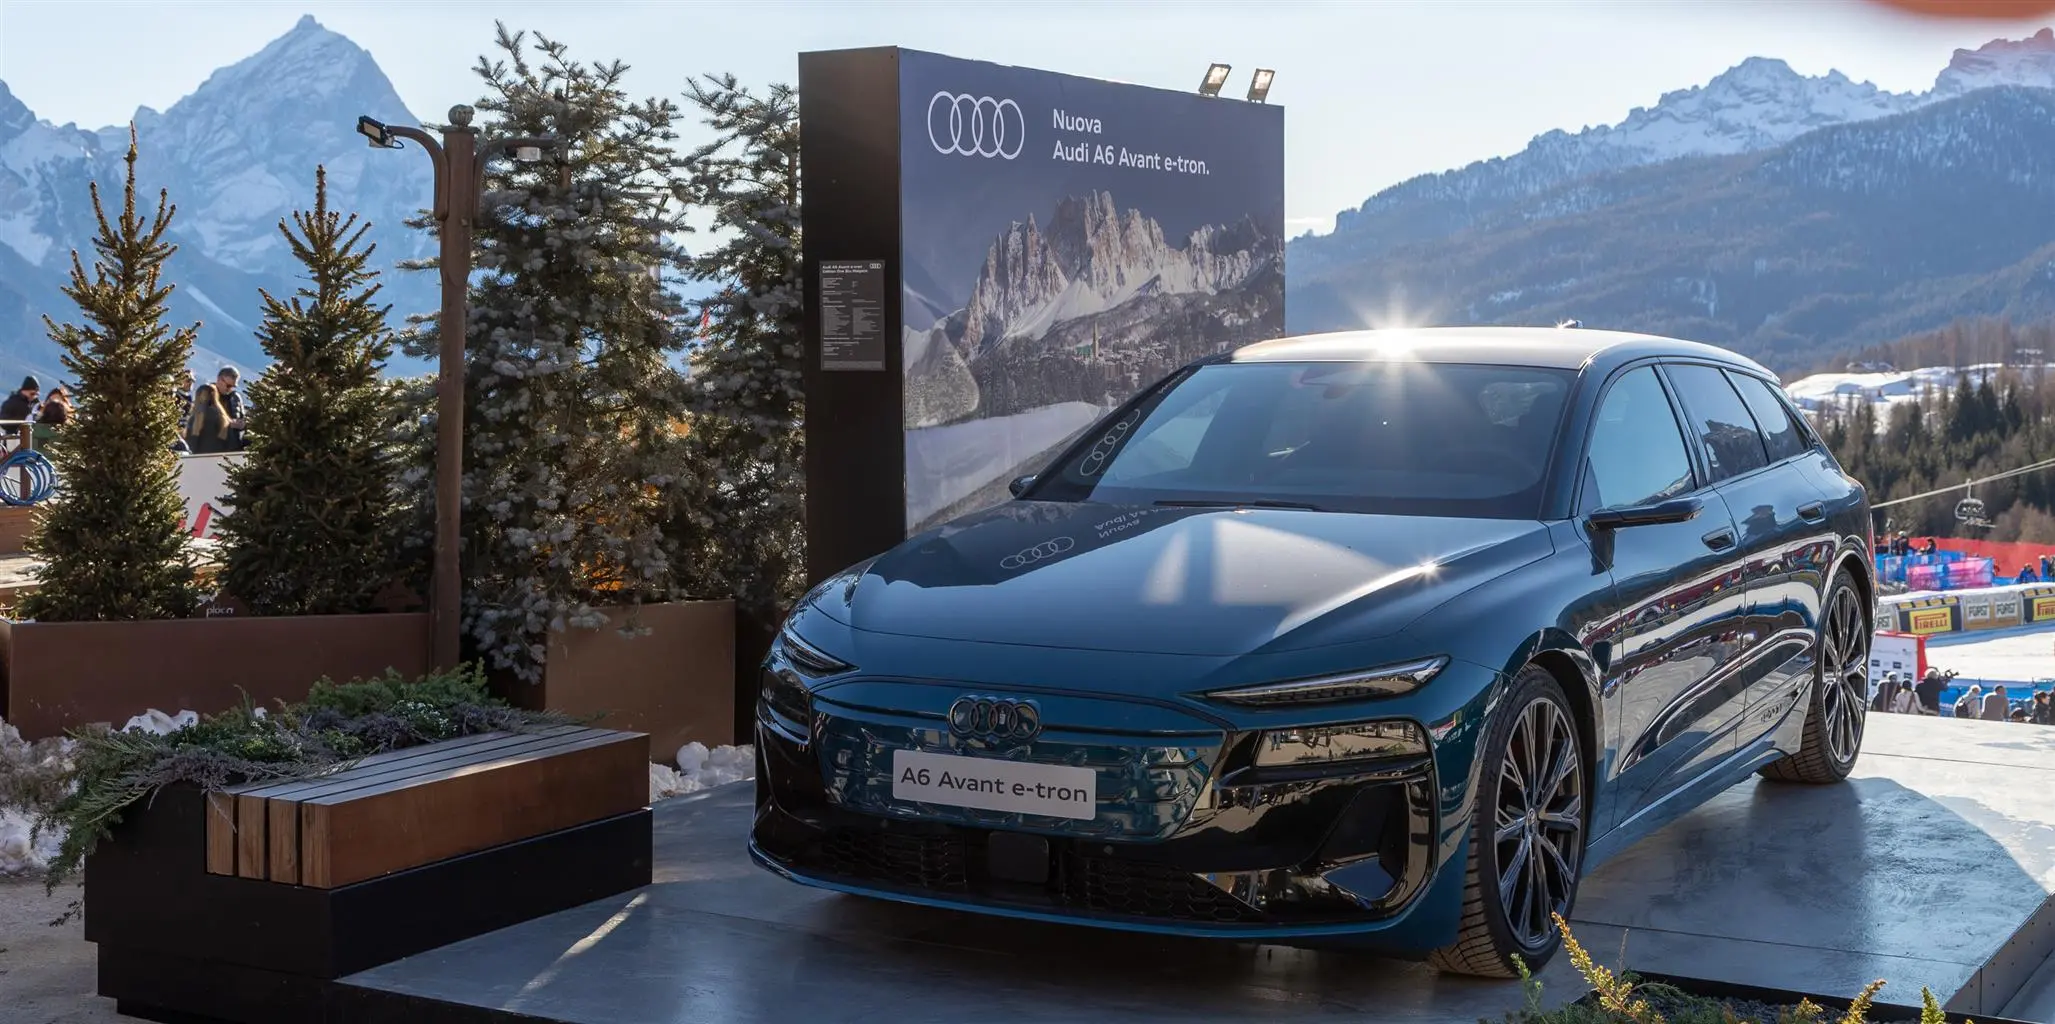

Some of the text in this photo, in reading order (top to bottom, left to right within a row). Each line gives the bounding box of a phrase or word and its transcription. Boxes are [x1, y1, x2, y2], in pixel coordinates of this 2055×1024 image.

[1053, 108, 1102, 134] Nuova
[1053, 139, 1210, 175] Audi A6 Avant e-tron.
[1914, 612, 1948, 630] PIRELLI
[901, 767, 1088, 803] A6 Avant e-tron
